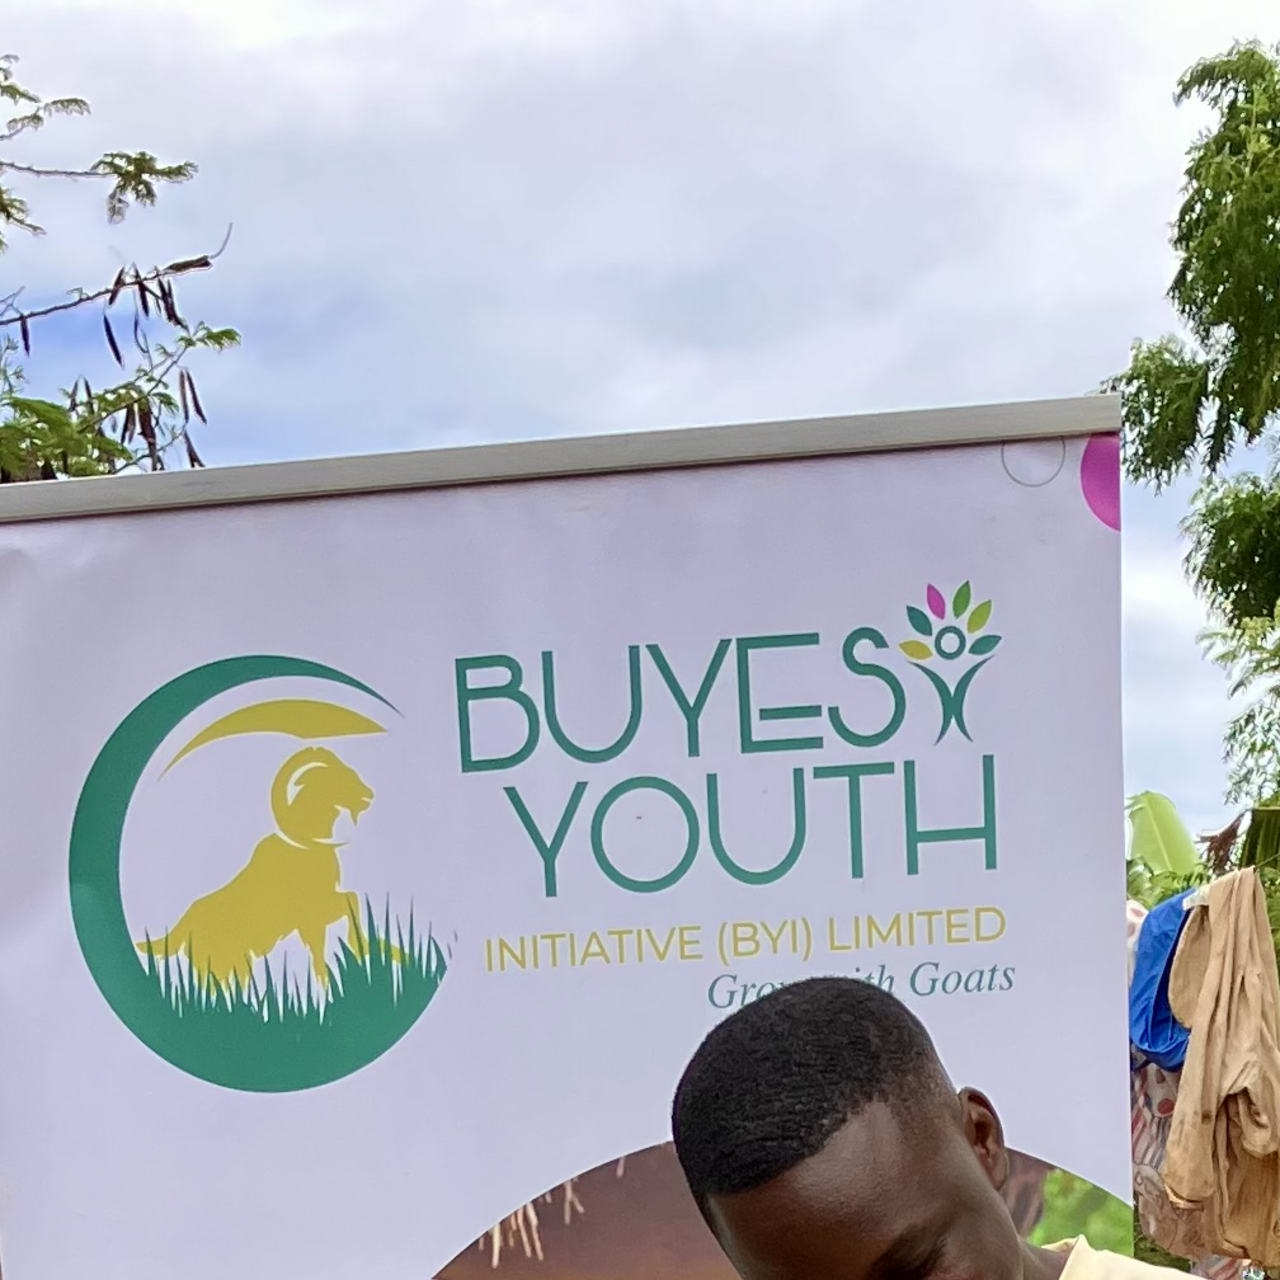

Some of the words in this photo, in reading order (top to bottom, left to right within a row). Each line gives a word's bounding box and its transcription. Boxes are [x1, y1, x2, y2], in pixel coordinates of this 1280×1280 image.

[503, 754, 997, 897] YOUTH
[485, 926, 702, 971] INITIATIVE
[718, 917, 812, 966] (BYI)
[828, 907, 1006, 952] LIMITED
[707, 974, 784, 1010] Gro
[910, 961, 1016, 997] Goats
